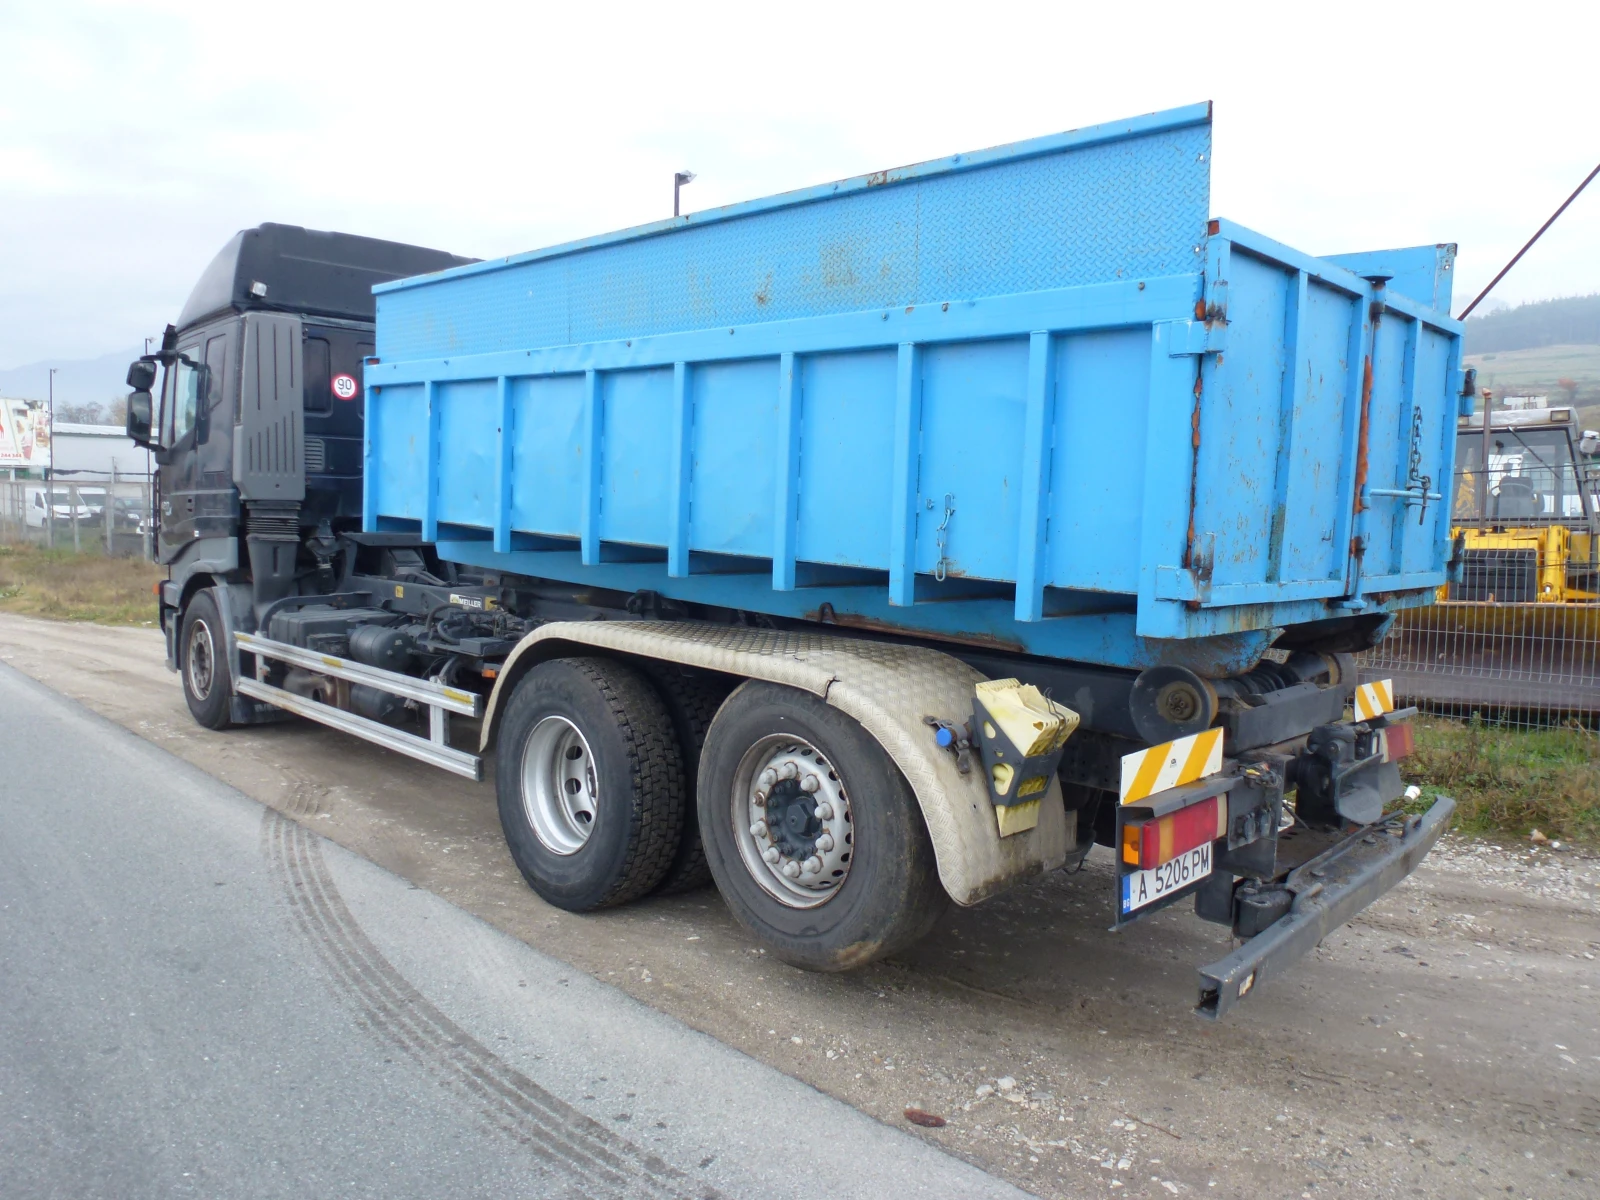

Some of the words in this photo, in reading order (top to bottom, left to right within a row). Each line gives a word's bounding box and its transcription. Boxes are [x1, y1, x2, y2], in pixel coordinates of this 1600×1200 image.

[337, 378, 352, 390] 90
[459, 598, 482, 608] MEILLER
[1138, 873, 1148, 902] A
[1155, 854, 1190, 894] 5206
[1192, 845, 1210, 877] PM
[1122, 898, 1130, 909] BG
